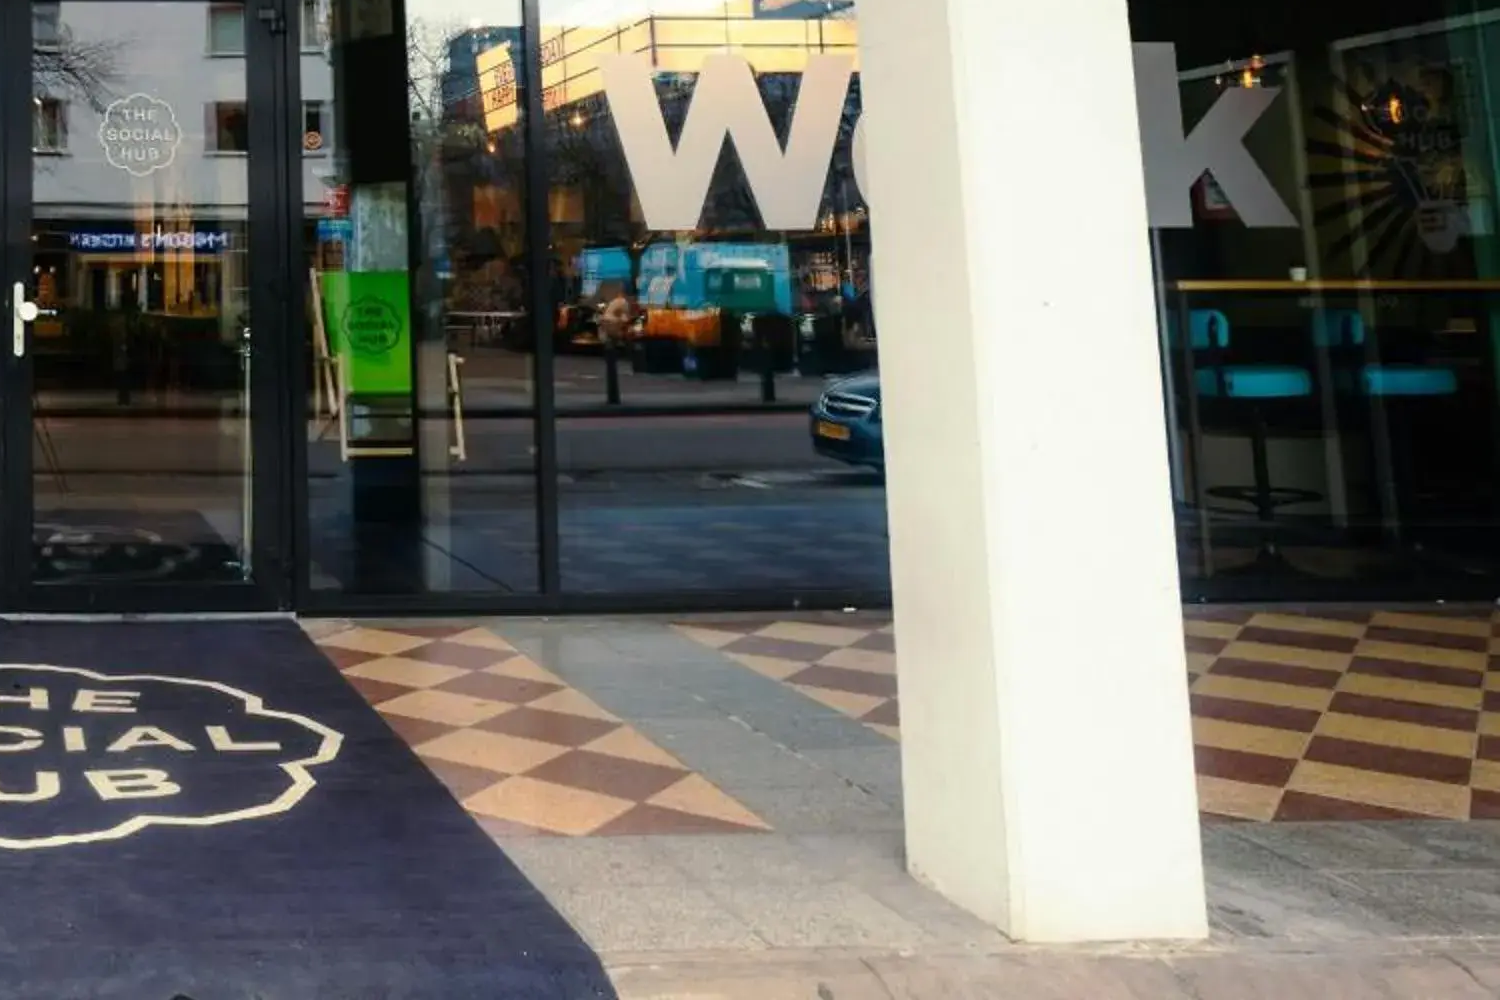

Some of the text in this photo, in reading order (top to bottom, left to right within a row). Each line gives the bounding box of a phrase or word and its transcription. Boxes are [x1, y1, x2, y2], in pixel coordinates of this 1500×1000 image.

[122, 109, 157, 121] THE
[107, 128, 174, 141] SOCIAL
[599, 41, 1300, 228] Wk
[121, 147, 160, 161] HUB
